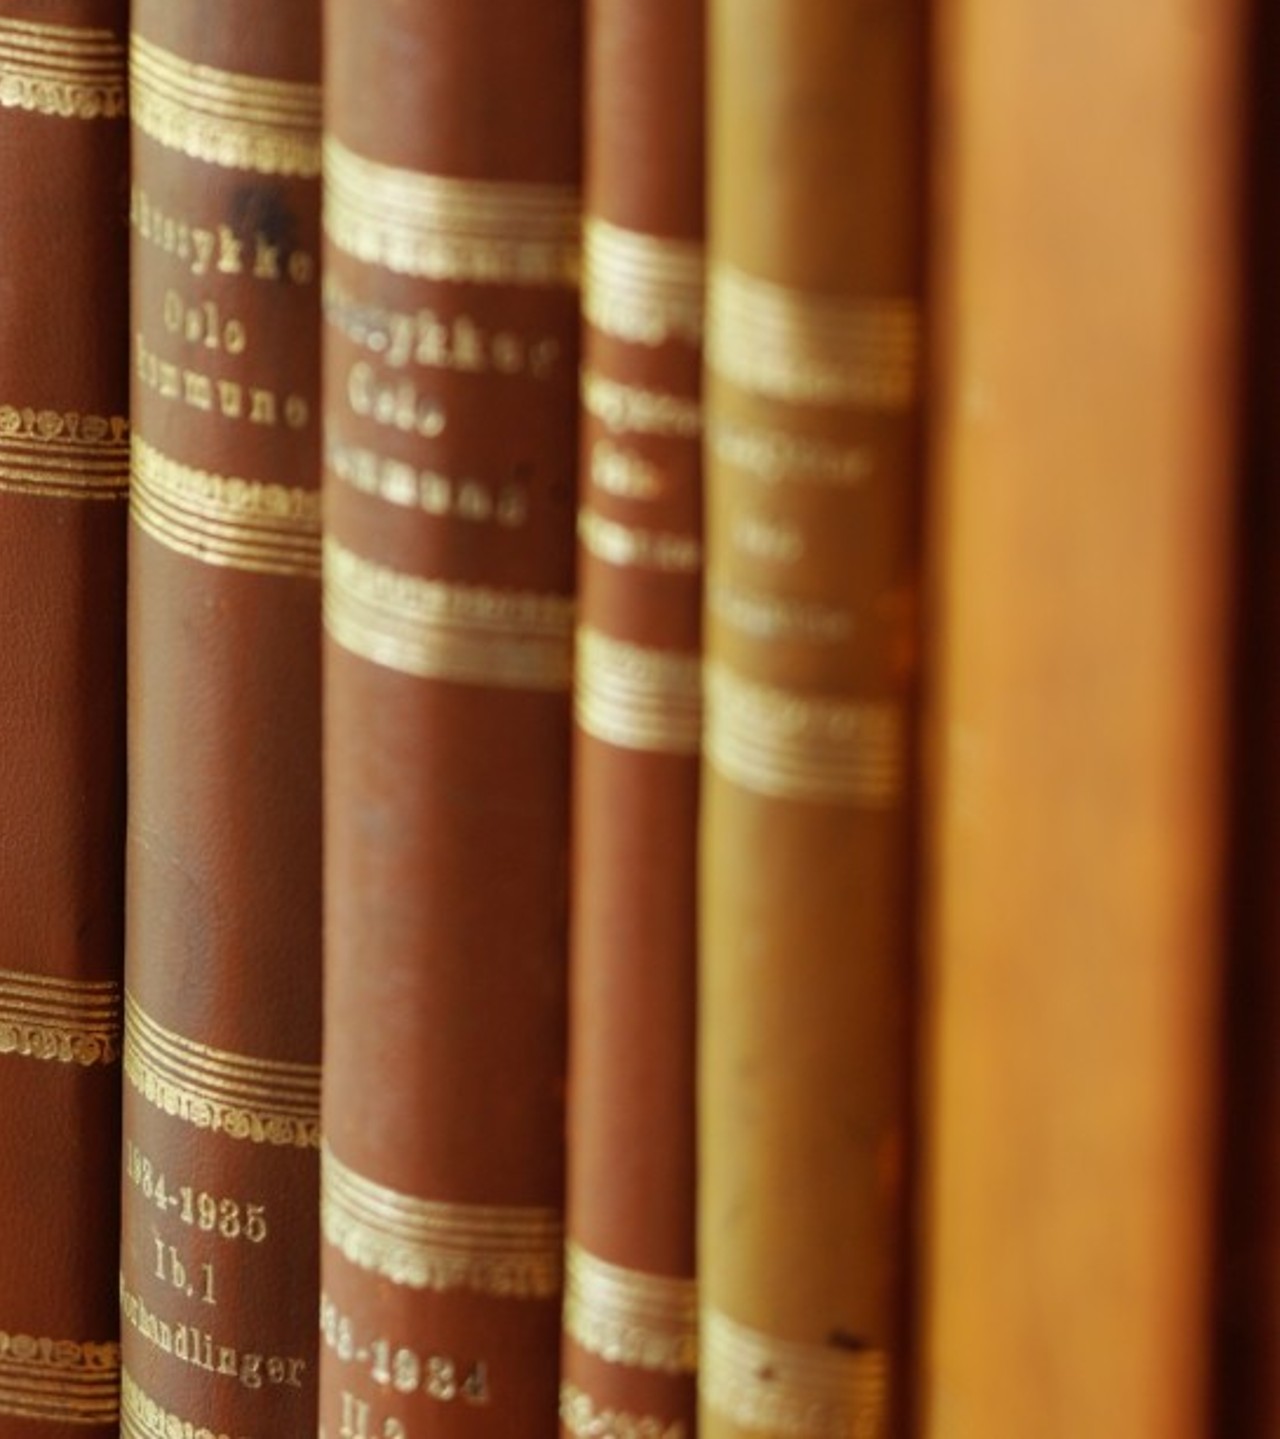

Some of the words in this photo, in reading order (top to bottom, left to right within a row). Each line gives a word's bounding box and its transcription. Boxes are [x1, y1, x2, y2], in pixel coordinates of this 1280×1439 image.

[130, 188, 312, 286] ktstykke
[163, 288, 246, 354] Oslo
[328, 300, 560, 382] ykker
[127, 1140, 267, 1242] 1934-1935
[154, 1236, 217, 1305] Ib.1
